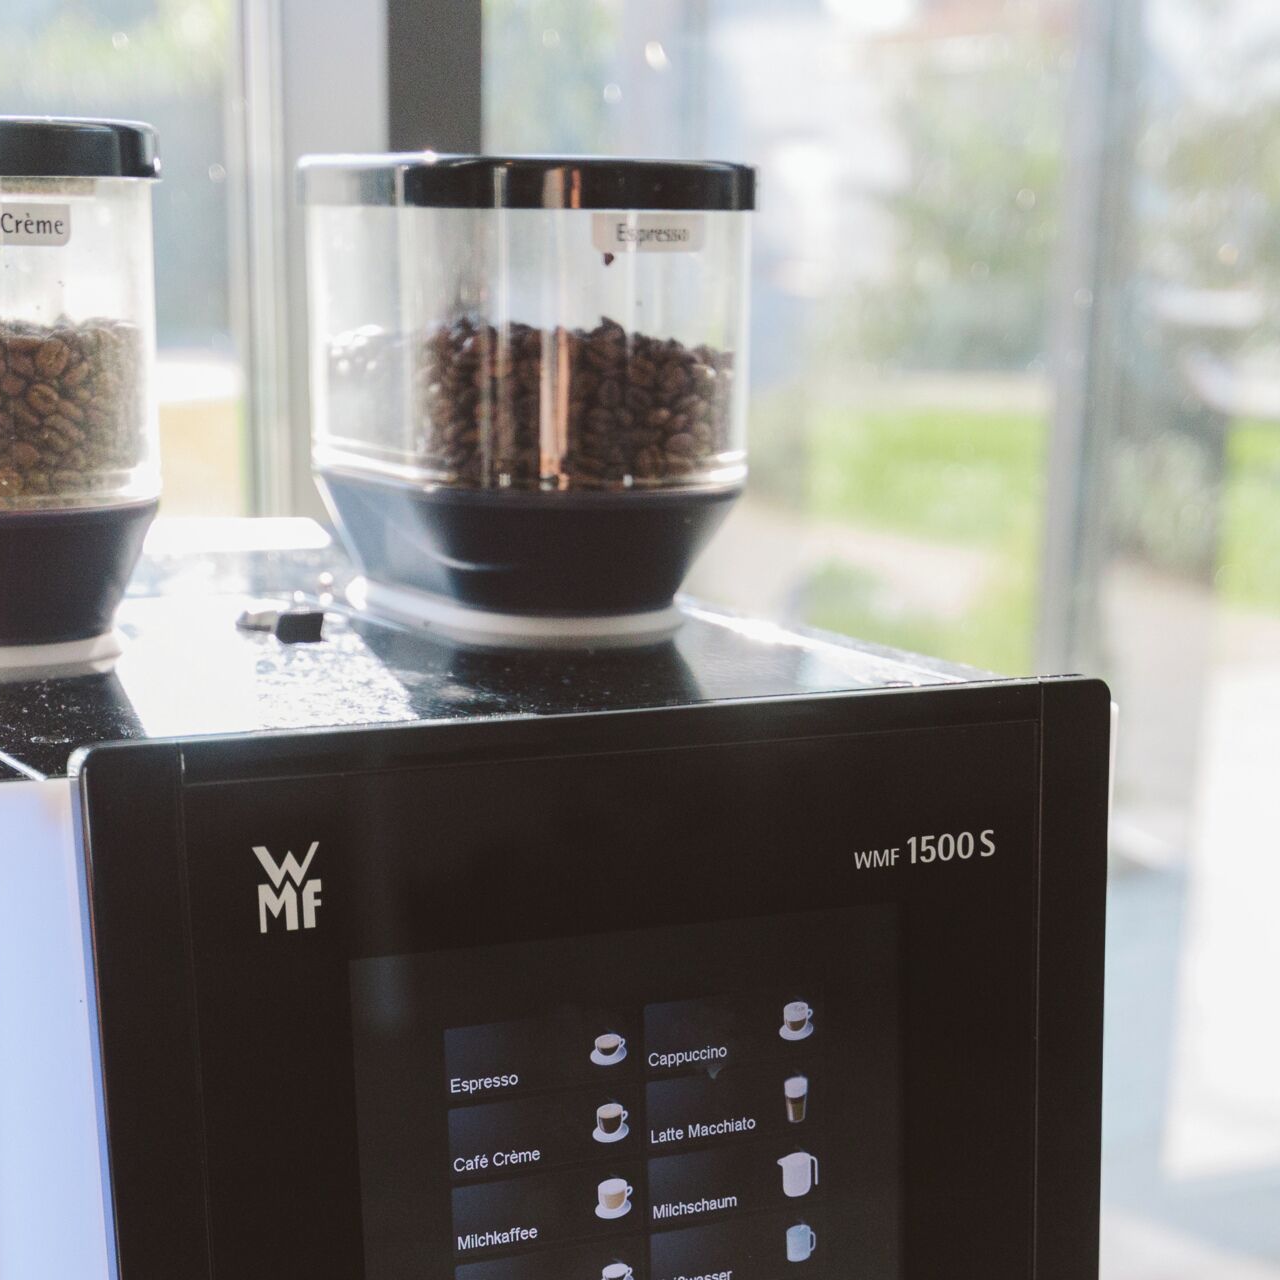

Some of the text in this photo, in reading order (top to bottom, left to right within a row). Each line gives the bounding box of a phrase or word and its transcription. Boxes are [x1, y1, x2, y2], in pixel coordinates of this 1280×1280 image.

[0, 212, 64, 235] Crème
[854, 848, 900, 870] WMF
[906, 831, 975, 864] 1500
[648, 1045, 728, 1067] Cappuccino
[450, 1072, 519, 1094] Espresso
[651, 1116, 756, 1143] Latte Macchiato
[453, 1148, 540, 1172] Café Crème
[652, 1195, 738, 1219] Milchschaum
[457, 1226, 538, 1251] Milchkaffee
